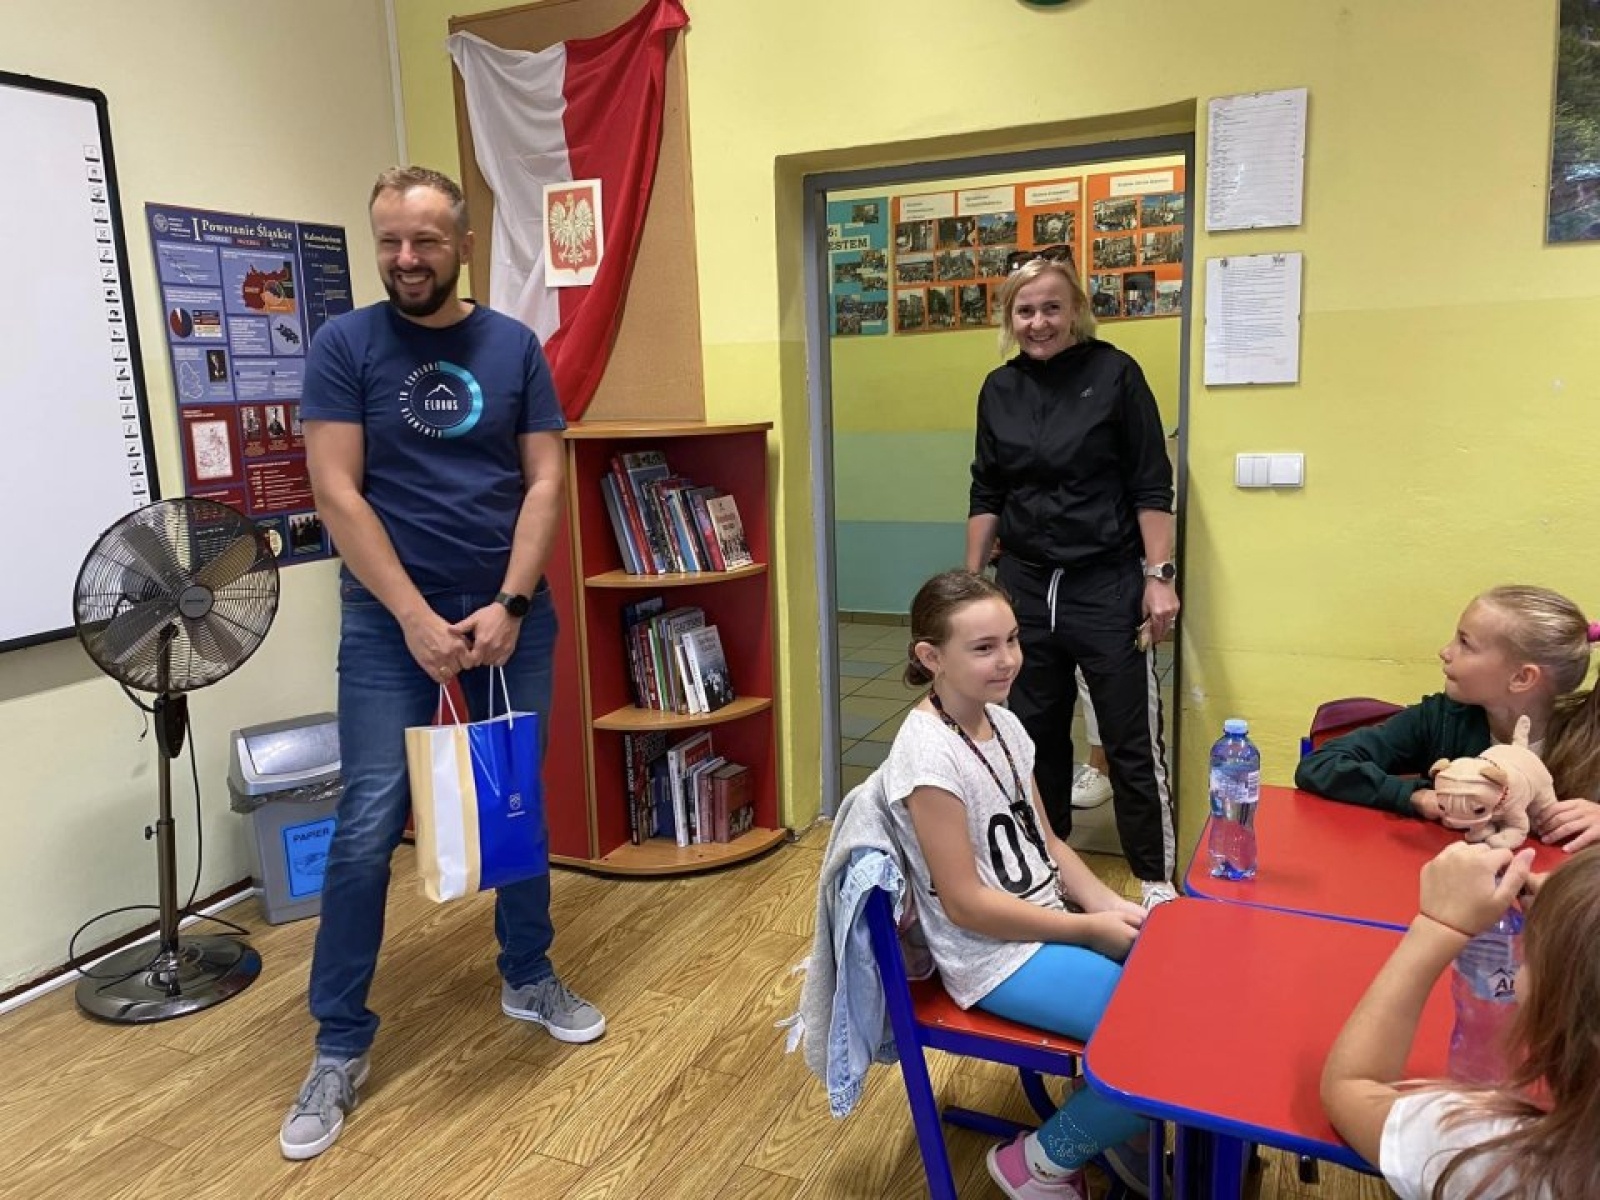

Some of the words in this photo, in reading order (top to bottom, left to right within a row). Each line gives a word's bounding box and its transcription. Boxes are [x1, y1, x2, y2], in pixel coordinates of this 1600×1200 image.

[192, 217, 202, 242] I
[202, 219, 256, 236] Powstanie
[257, 222, 293, 241] Śląskie
[293, 827, 329, 842] PAPIER
